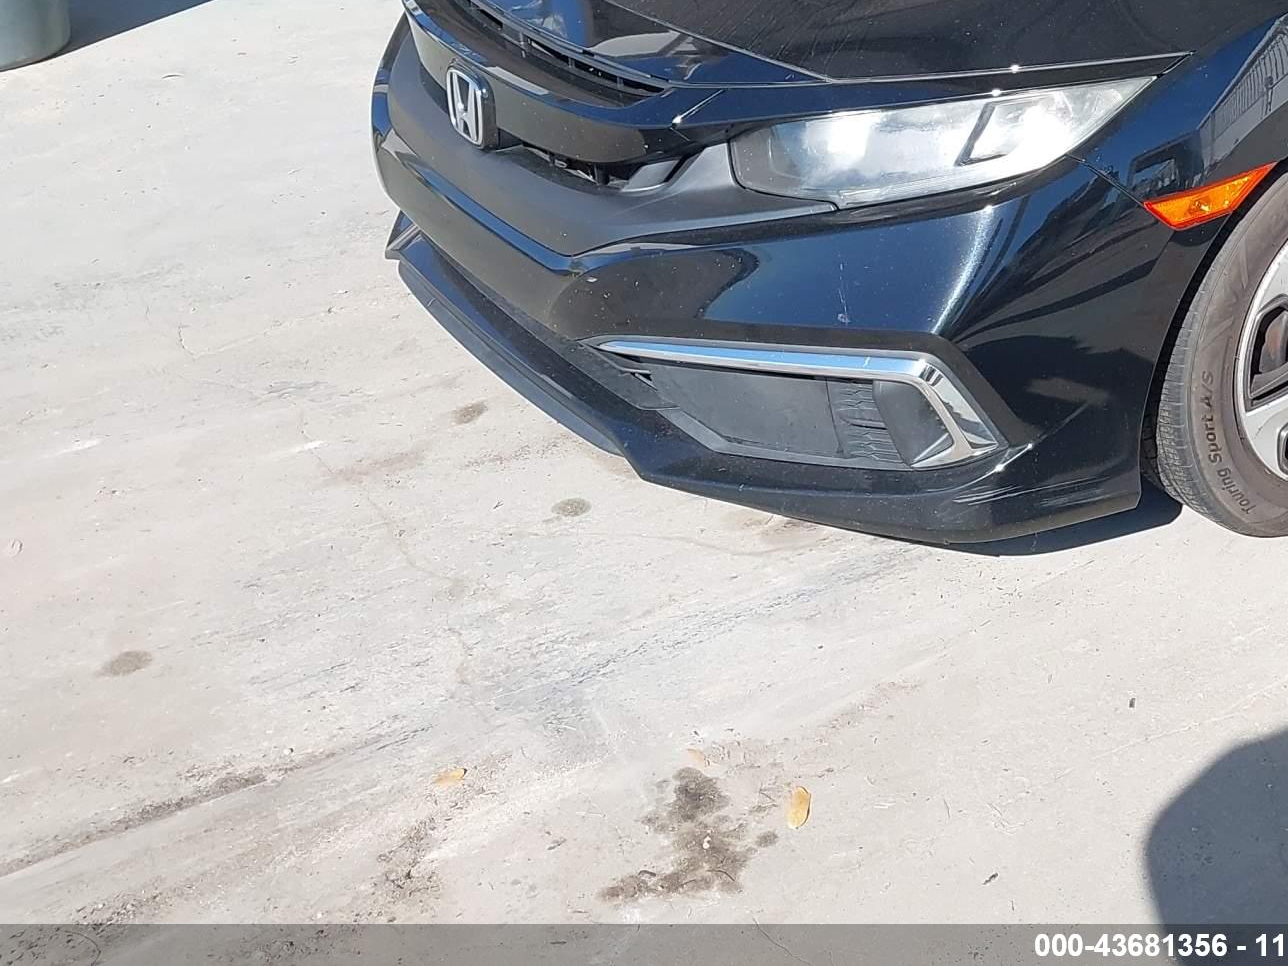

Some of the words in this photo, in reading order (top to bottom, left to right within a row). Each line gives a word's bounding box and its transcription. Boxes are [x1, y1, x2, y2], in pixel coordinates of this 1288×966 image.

[1200, 370, 1214, 409] A/S
[1202, 414, 1223, 464] Sport
[1216, 466, 1257, 515] Touring
